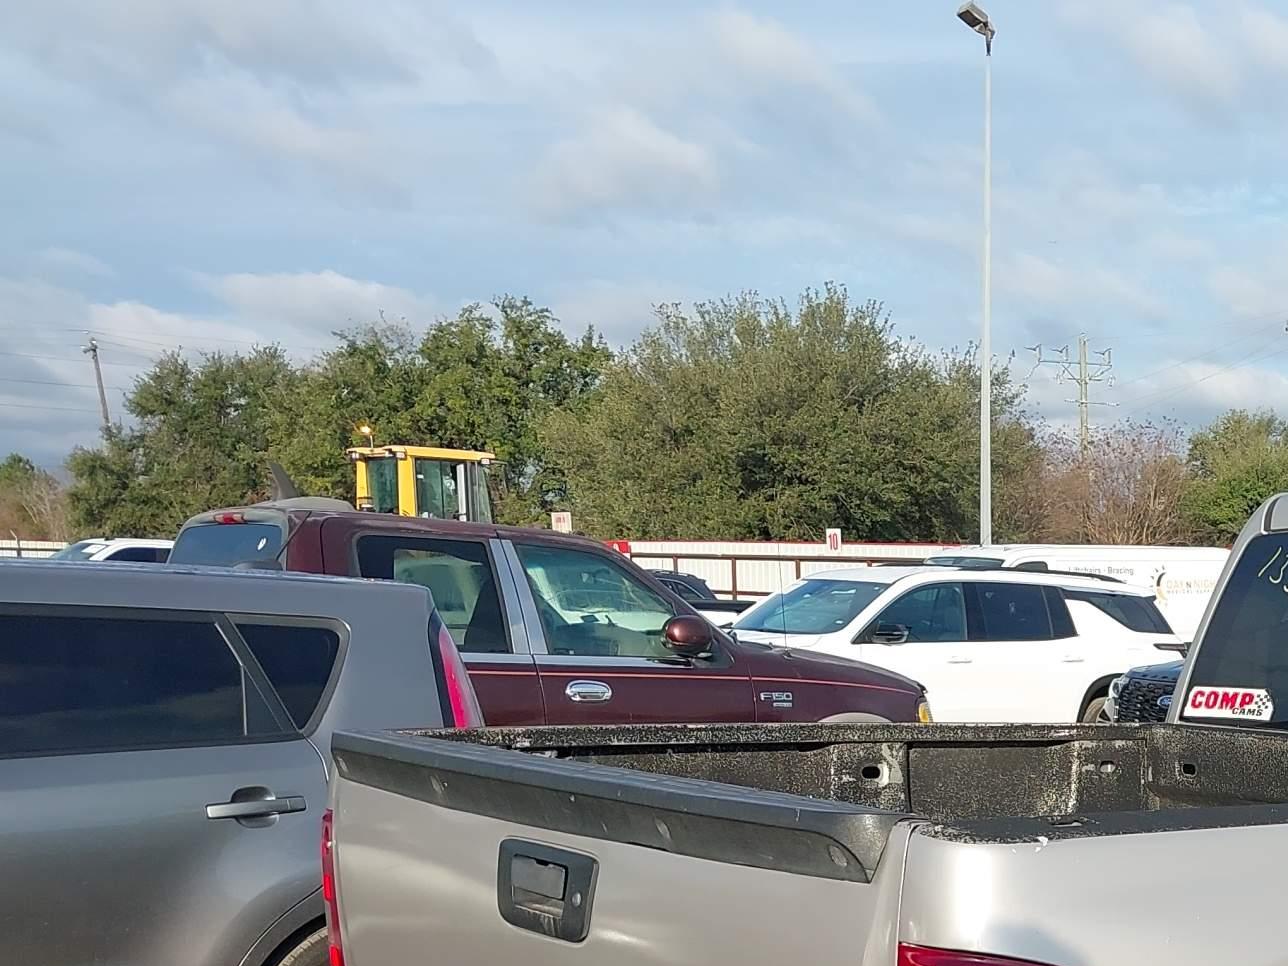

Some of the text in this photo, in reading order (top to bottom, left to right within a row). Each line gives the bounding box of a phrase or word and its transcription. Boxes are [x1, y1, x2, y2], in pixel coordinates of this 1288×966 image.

[828, 532, 839, 551] 10
[1107, 566, 1135, 576] Bracing
[1190, 690, 1255, 710] COMP
[1231, 707, 1264, 717] CAMS
